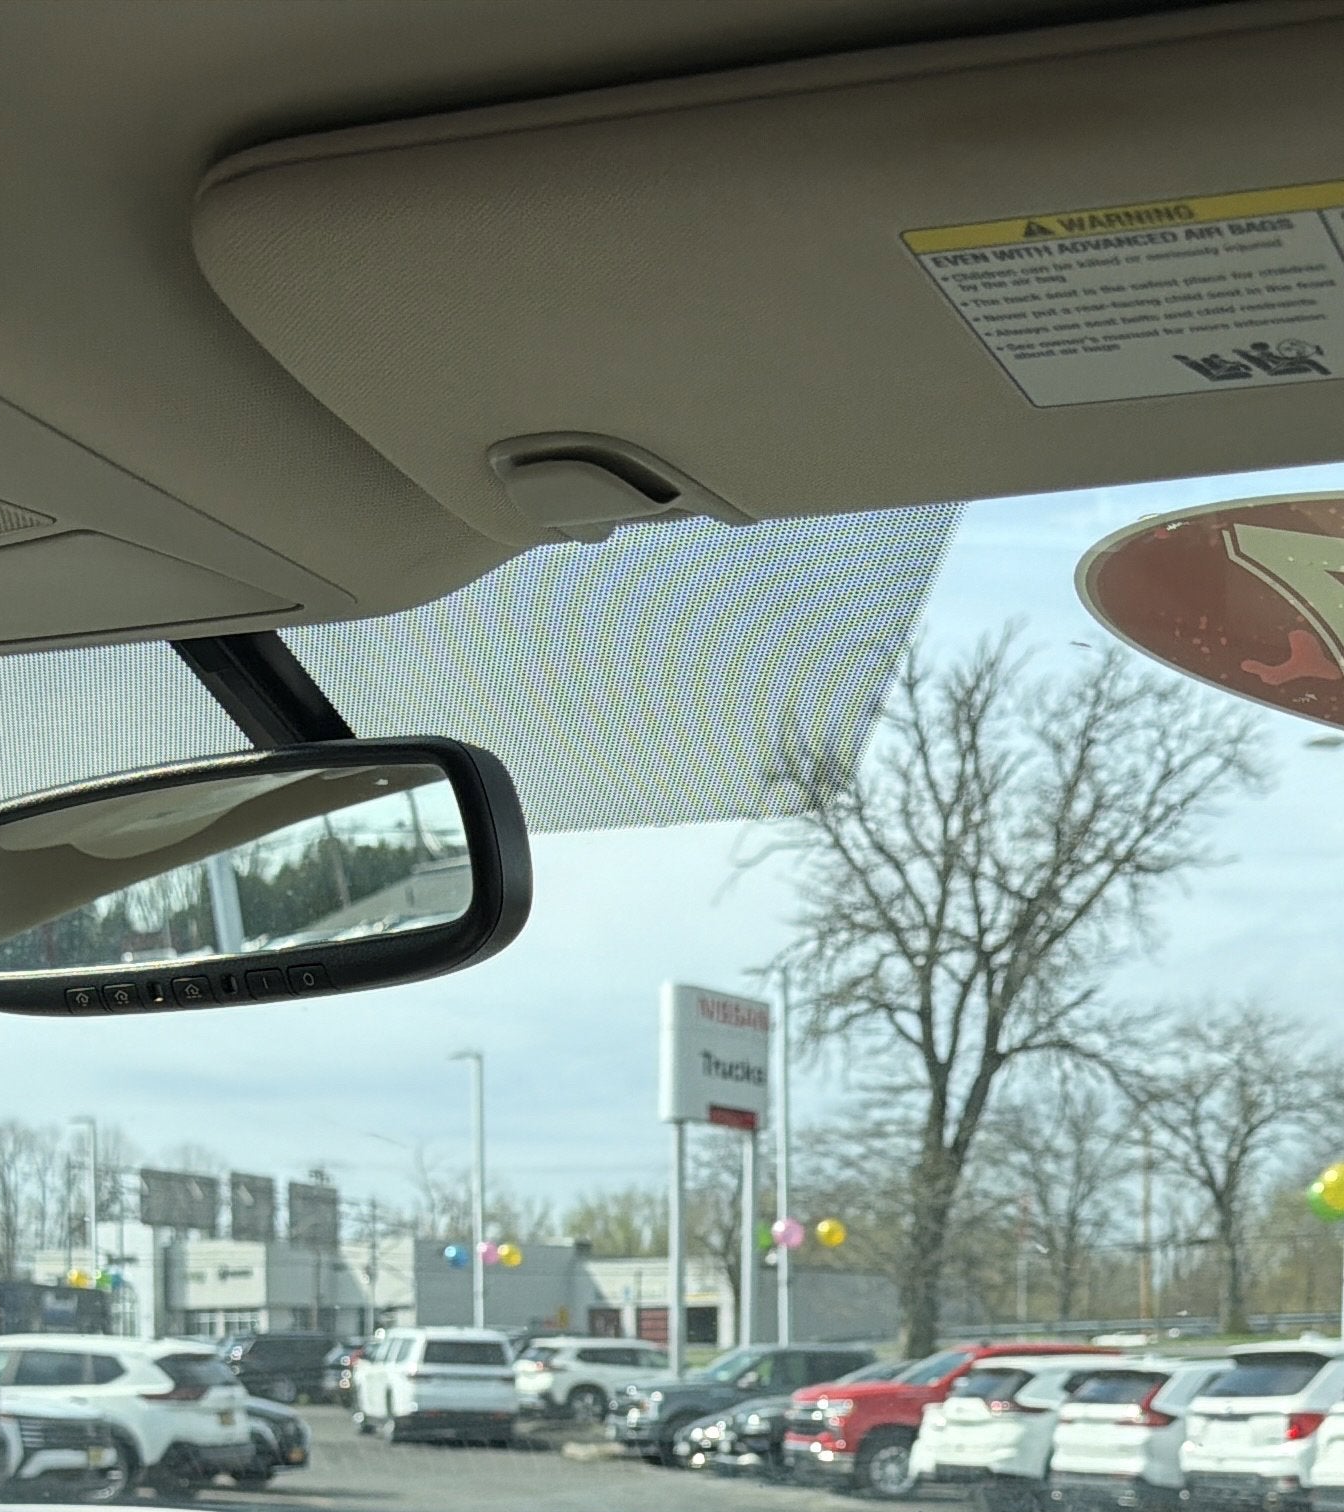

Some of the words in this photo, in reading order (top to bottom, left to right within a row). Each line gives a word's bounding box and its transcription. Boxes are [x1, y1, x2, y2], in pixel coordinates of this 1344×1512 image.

[1057, 204, 1195, 233] WARNING
[931, 251, 990, 268] EVEN
[992, 244, 1053, 262] WITH
[1058, 231, 1178, 255] ADVANCED
[1184, 226, 1224, 241] AIR
[1228, 217, 1295, 236] BAGS
